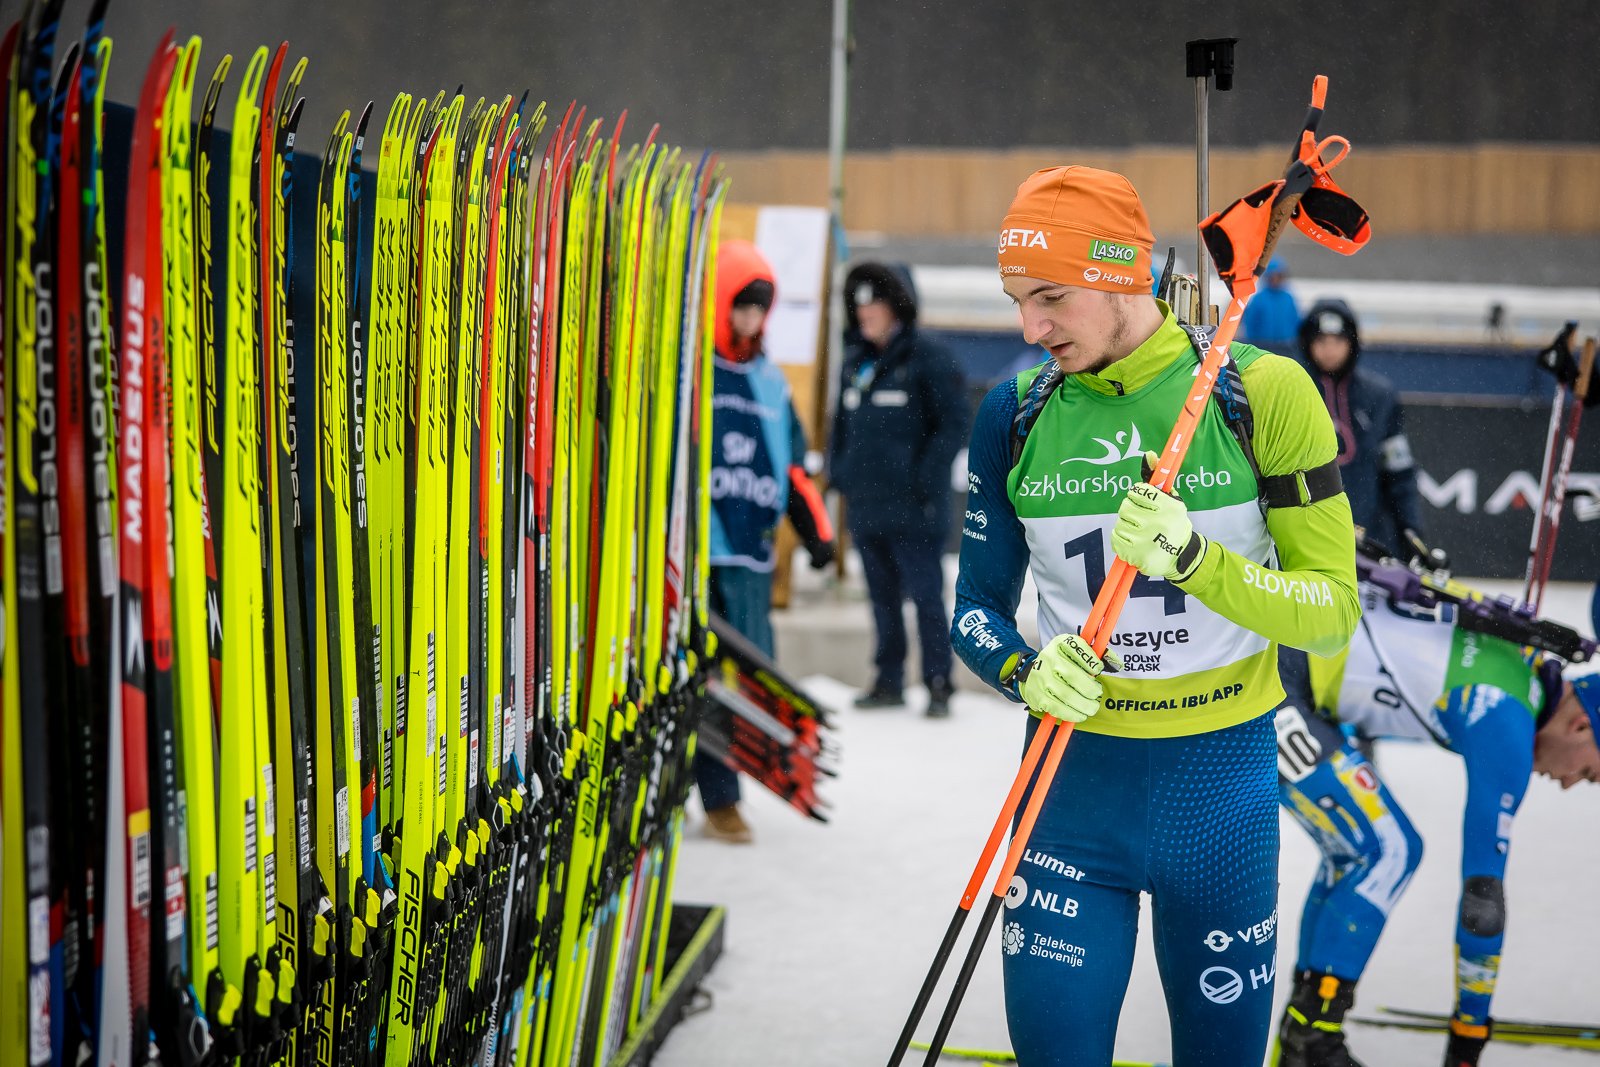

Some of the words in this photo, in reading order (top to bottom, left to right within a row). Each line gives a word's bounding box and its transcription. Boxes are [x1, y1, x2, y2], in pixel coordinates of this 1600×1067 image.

[199, 151, 220, 456] FISCHER
[274, 152, 292, 457] FISCHER
[320, 202, 335, 495] FISCHER
[373, 216, 387, 466] FISCHER
[383, 217, 395, 462] FISCHER
[395, 217, 407, 458] FISCHER
[427, 218, 441, 471] FISCHER
[439, 220, 450, 466] FISCHER
[463, 222, 476, 459] FISCHER
[1101, 272, 1134, 286] HALTI
[124, 273, 147, 545] MADSHUS
[336, 259, 350, 517] FISCHER
[352, 320, 367, 529] salomon
[527, 281, 540, 451] MADSHUS
[1019, 469, 1133, 502] Szklarska
[1176, 466, 1232, 493] ręba
[1064, 527, 1187, 617] 14
[1109, 628, 1190, 652] uszyce
[1243, 563, 1335, 607] SLOVENIA
[1104, 697, 1178, 712] OFFICIAL
[1181, 693, 1209, 709] IBU
[1211, 683, 1244, 703] APP
[1123, 654, 1162, 663] DOLNY
[579, 718, 605, 839] FISCHER
[1023, 848, 1086, 882] Lumar
[1030, 889, 1079, 918] NLB
[1033, 932, 1086, 957] Telekom
[394, 867, 421, 1027] FISCHER
[1029, 944, 1084, 968] Slovenije
